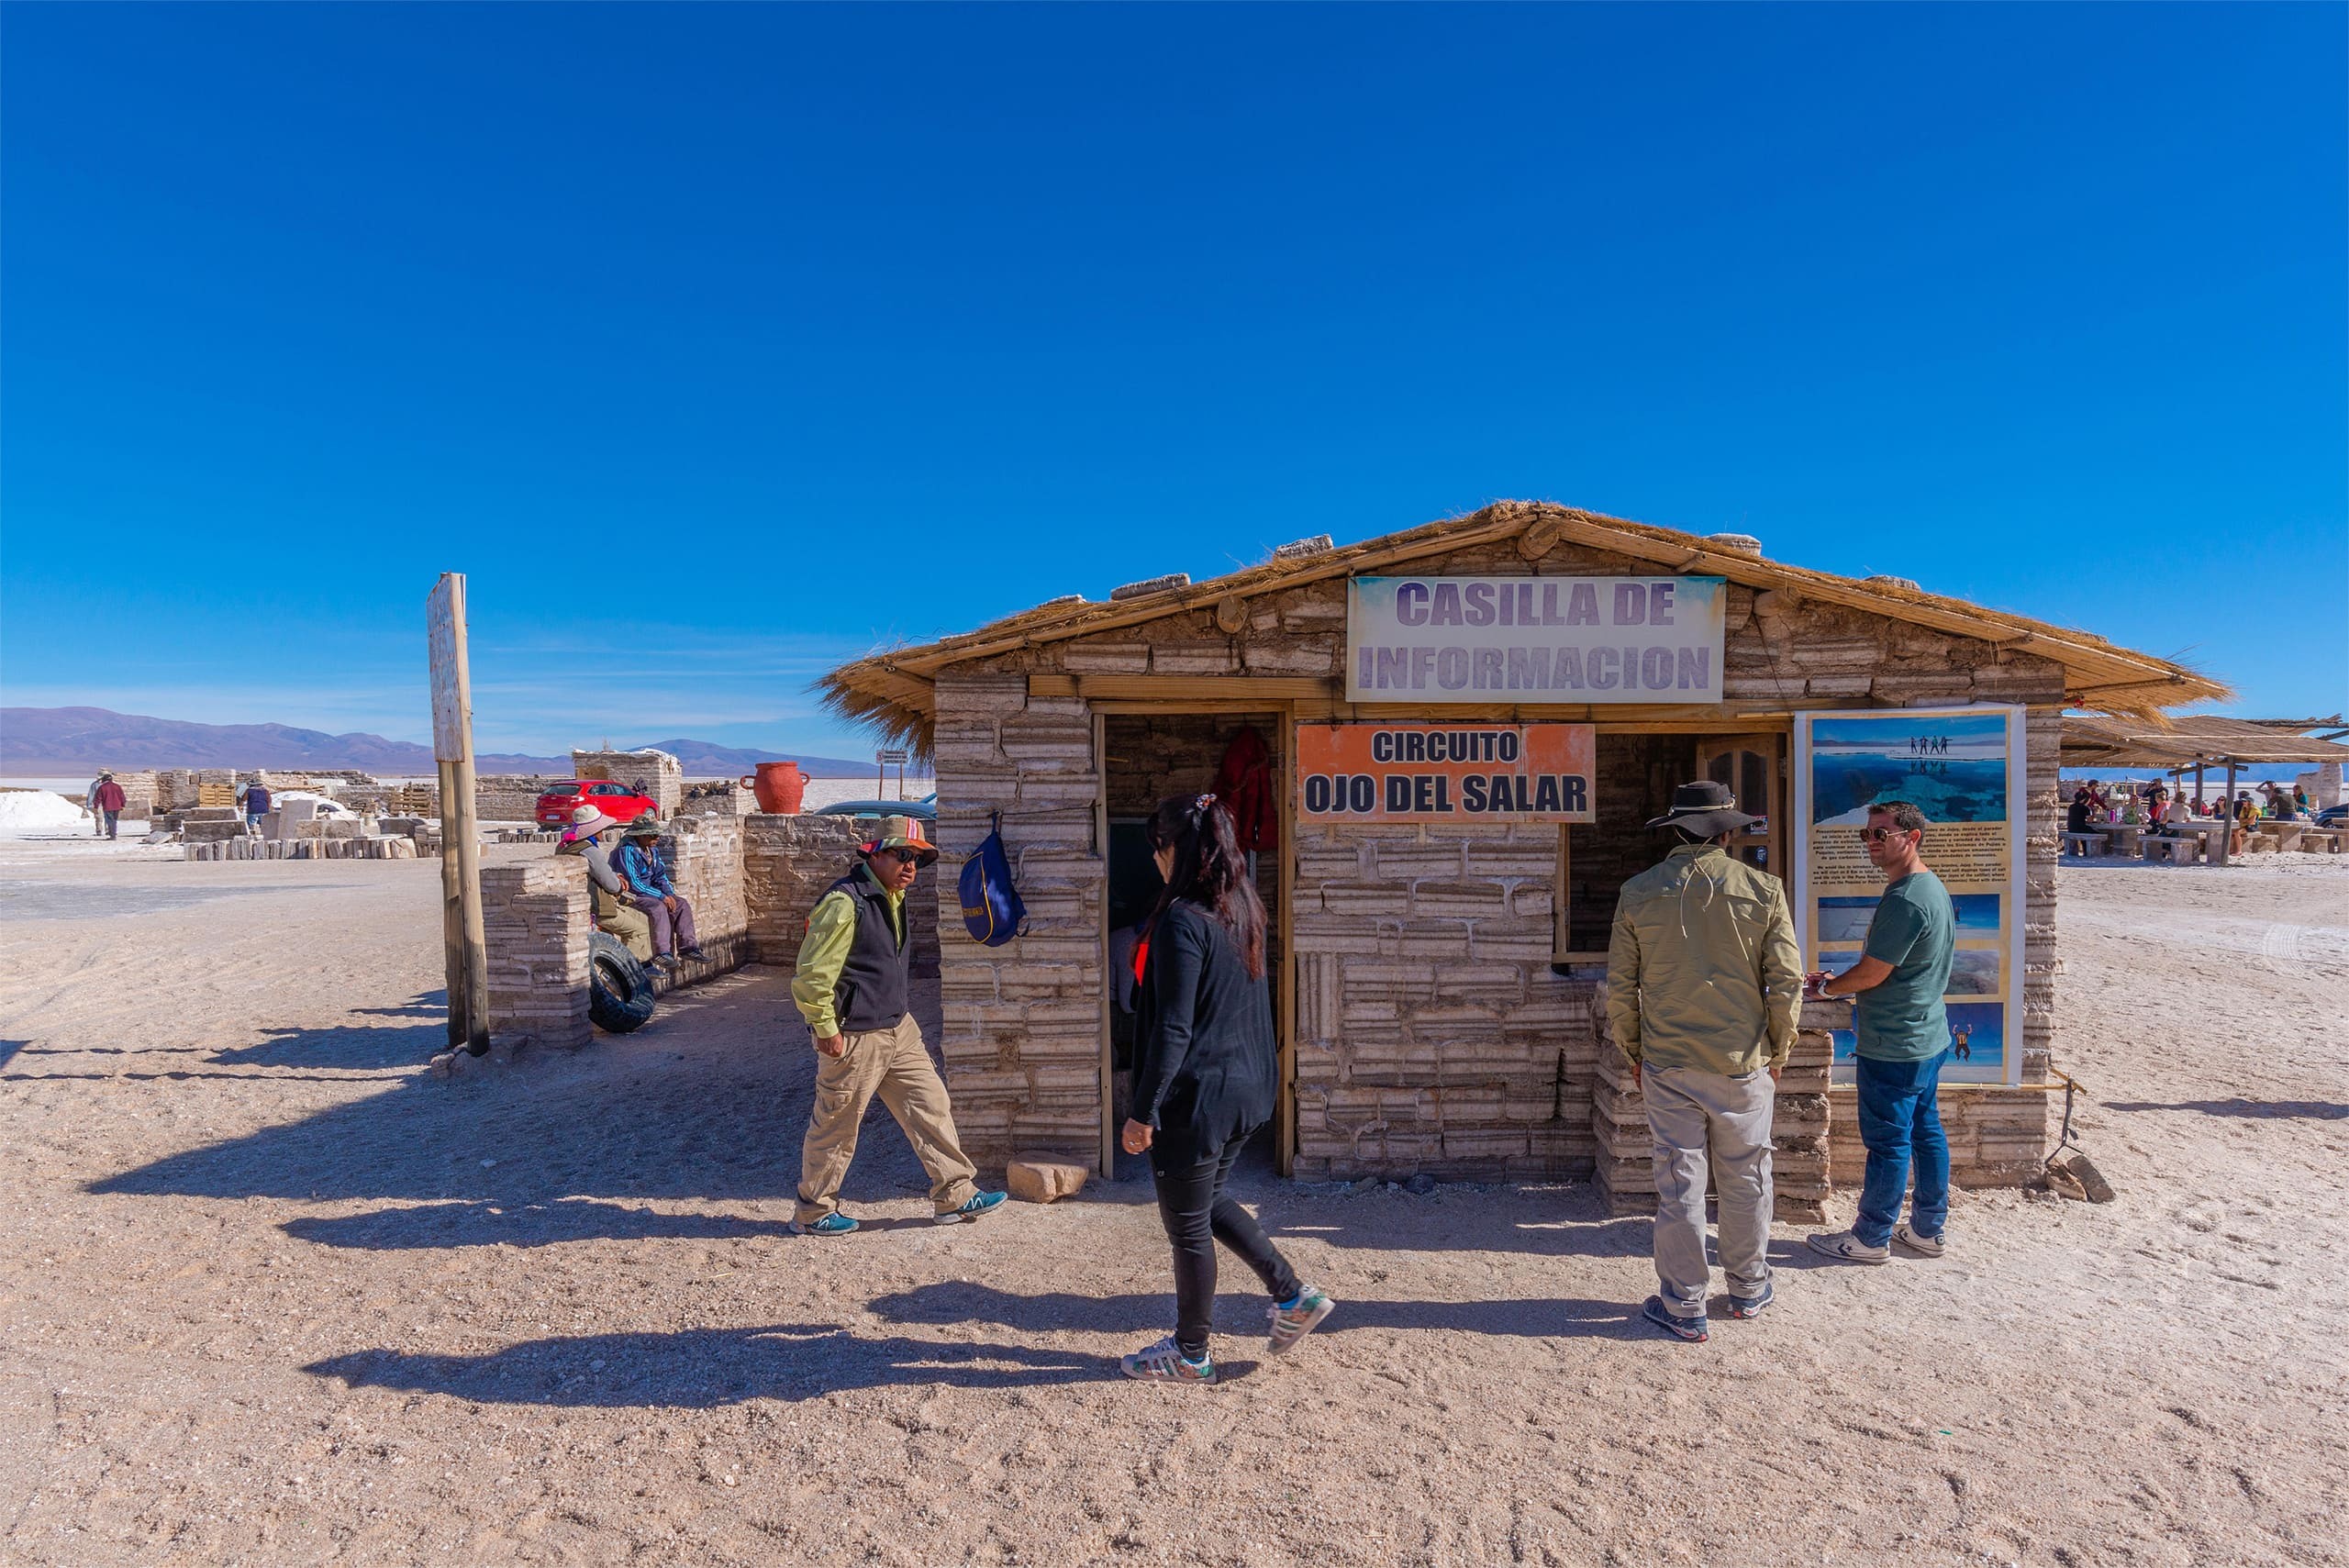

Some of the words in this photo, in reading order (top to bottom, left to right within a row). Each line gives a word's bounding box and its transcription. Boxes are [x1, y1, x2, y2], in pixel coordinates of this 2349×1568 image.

[1397, 583, 1600, 627] CASILLA
[1613, 583, 1675, 626] DE
[1358, 647, 1709, 690] INFORMACION
[1374, 731, 1519, 762] CIRCUITO
[1306, 775, 1375, 812] OJO
[1386, 775, 1453, 812] DEL
[1464, 775, 1586, 812] SALAR
